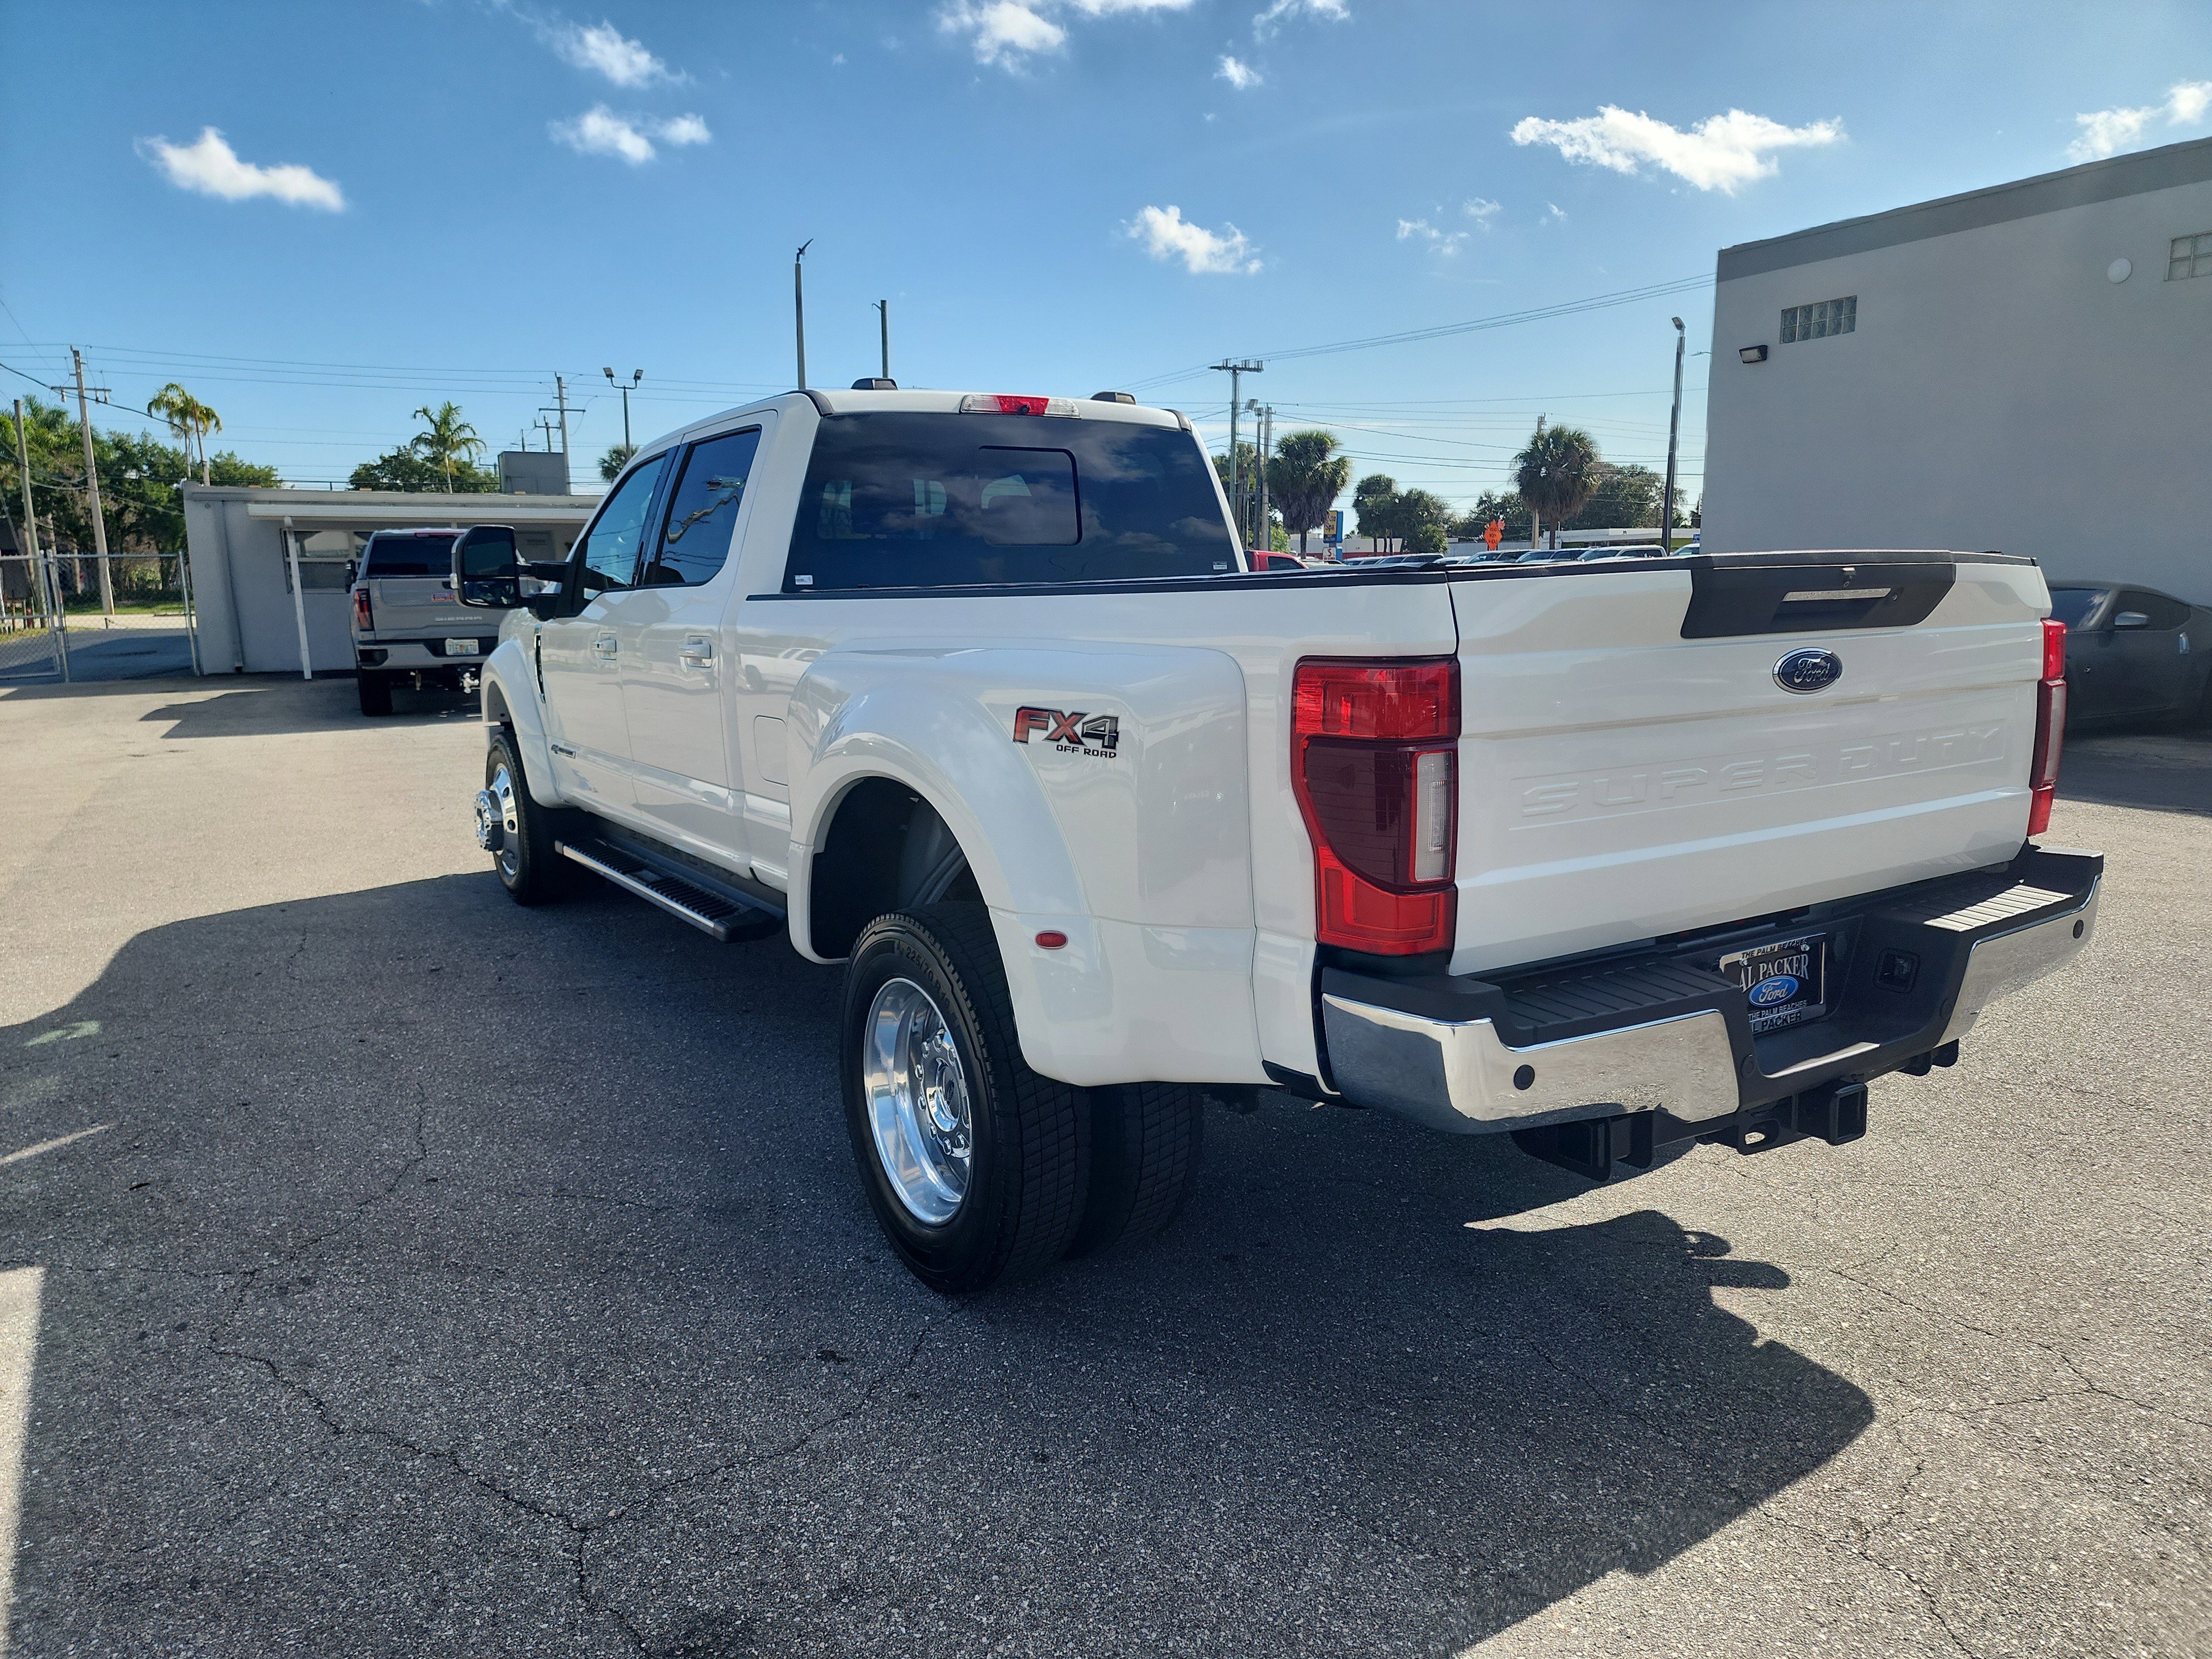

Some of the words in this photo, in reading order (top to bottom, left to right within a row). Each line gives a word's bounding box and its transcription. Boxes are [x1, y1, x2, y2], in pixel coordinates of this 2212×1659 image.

[1794, 658, 1830, 684] Ford
[1013, 705, 1120, 750] FX4
[1056, 744, 1079, 753] OFF
[1083, 748, 1117, 758] ROAD
[1522, 753, 1817, 818] SUPER
[1839, 727, 2000, 775] DUTY
[1741, 951, 1755, 959] THE
[1757, 945, 1776, 956] PALM
[1739, 966, 1756, 993] AL
[1759, 953, 1809, 981] PACKER
[1759, 981, 1789, 1003] Ford
[1748, 1011, 1760, 1021] THE
[1761, 1007, 1778, 1018] PALM
[1779, 1000, 1807, 1013] BEACHES
[1761, 1011, 1802, 1030] PACKER
